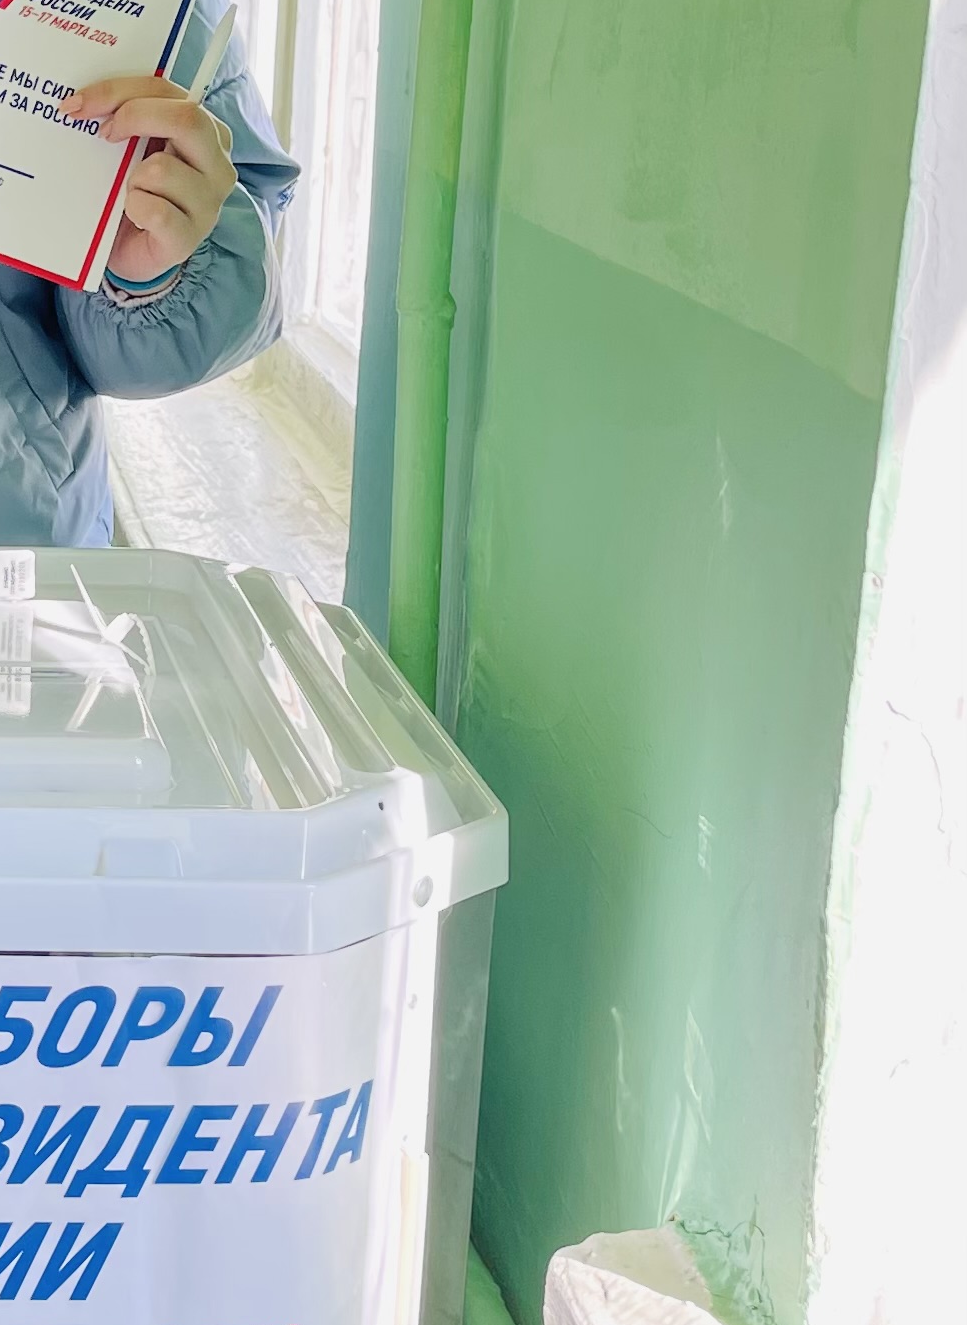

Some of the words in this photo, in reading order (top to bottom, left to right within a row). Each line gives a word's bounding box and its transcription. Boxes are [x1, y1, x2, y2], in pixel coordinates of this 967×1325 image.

[49, 16, 91, 38] МАРТА
[88, 29, 119, 47] 2024
[9, 68, 40, 91] МЫ
[9, 92, 29, 113] ЗА
